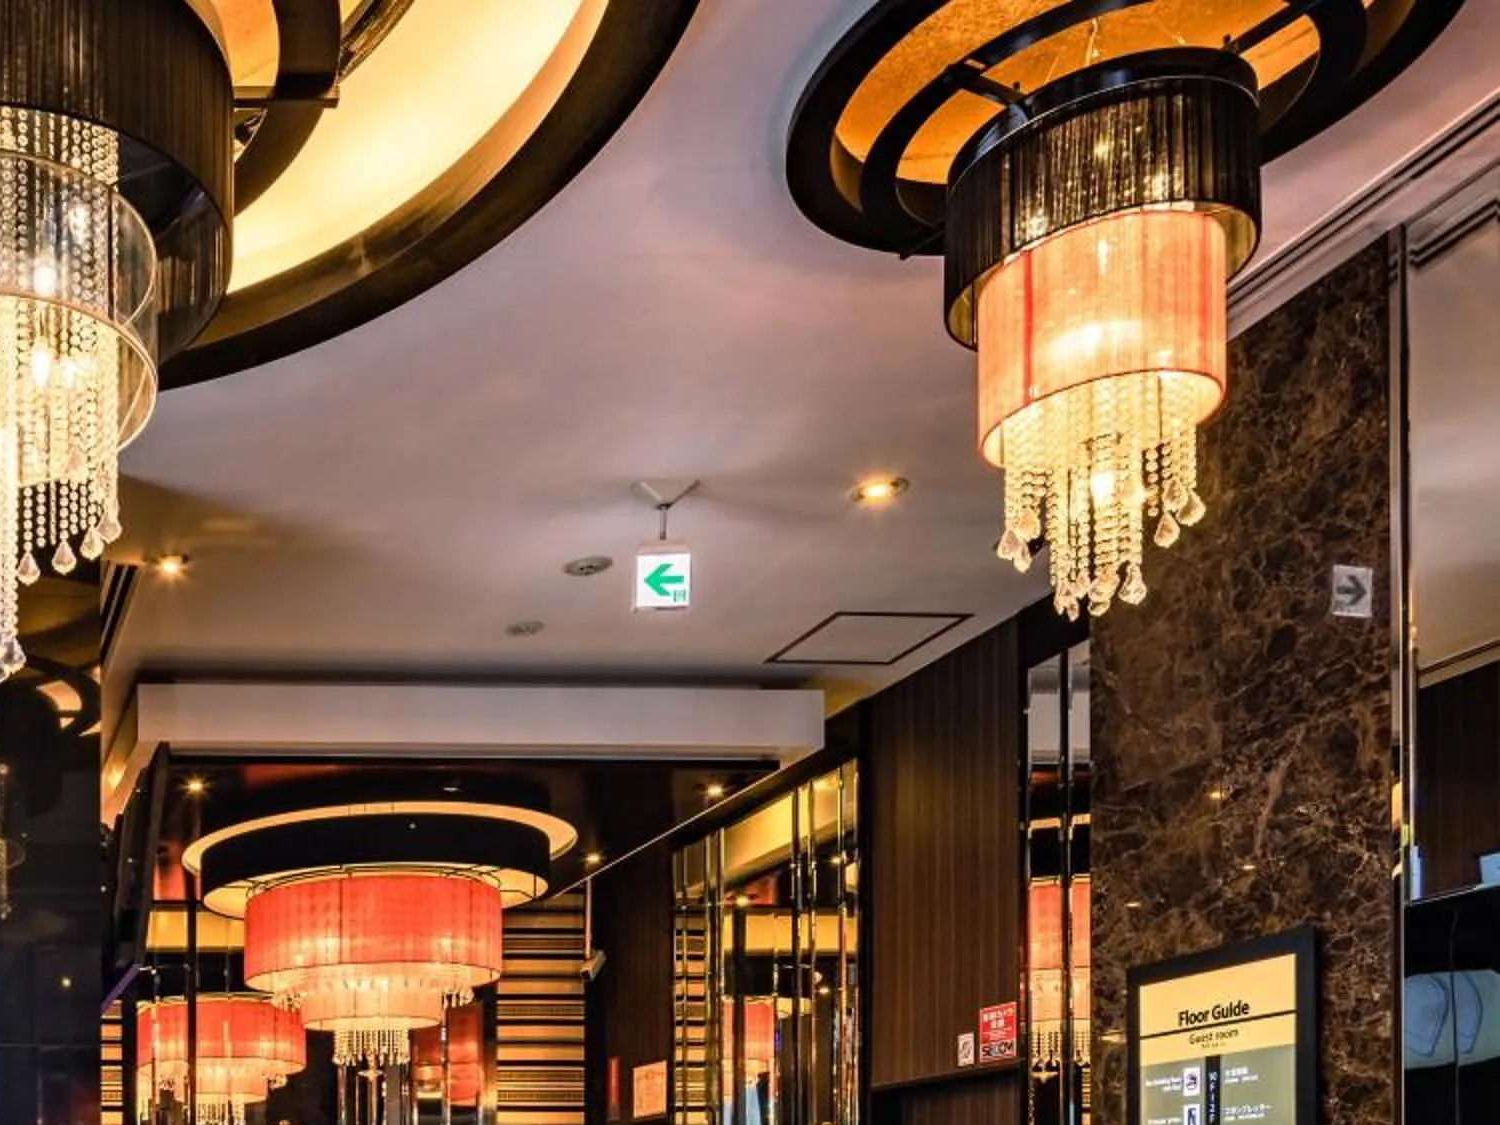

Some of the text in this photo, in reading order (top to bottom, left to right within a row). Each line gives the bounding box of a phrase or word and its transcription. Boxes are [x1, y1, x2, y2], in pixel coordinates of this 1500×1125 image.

[1178, 1000, 1250, 1026] Floor Guide
[1189, 1032, 1213, 1045] Guest
[1215, 1028, 1239, 1041] room
